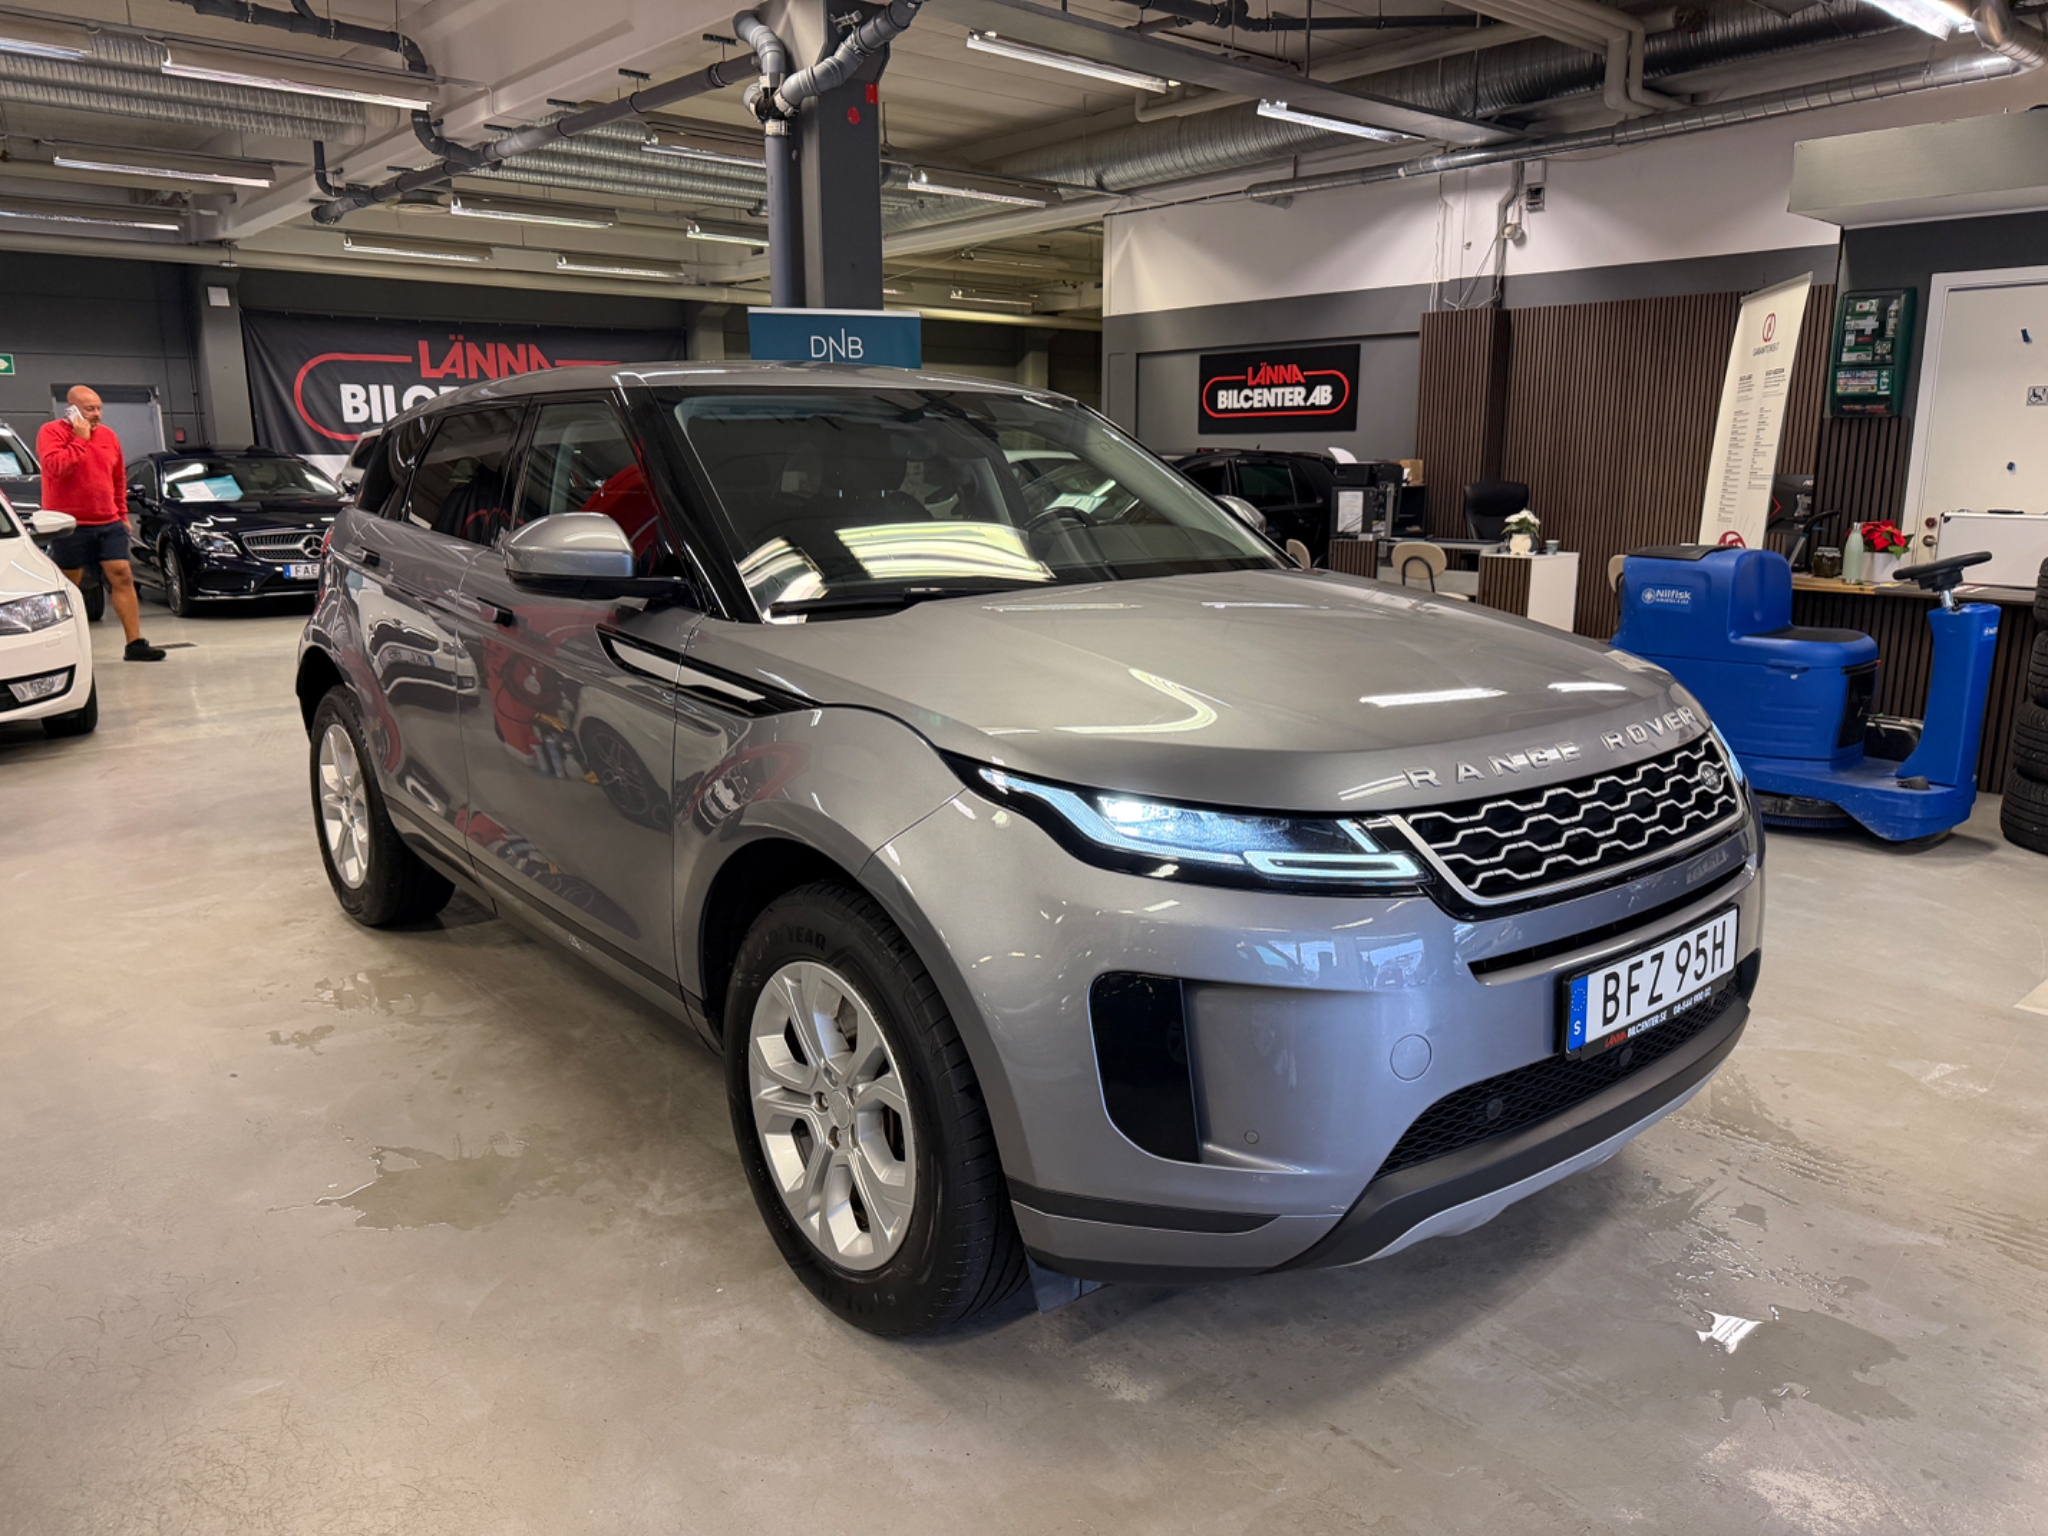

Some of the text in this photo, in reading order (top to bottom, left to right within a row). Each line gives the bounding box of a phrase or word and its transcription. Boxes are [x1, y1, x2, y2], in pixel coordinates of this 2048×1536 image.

[418, 334, 553, 380] LÄNNA
[810, 328, 864, 363] DNB
[1247, 362, 1306, 386] LÄNNA
[1217, 385, 1333, 409] BILCENTER AB
[1655, 588, 1691, 600] Nilfisk
[1403, 705, 1697, 790] RANGE ROVER
[1602, 920, 1726, 1027] BFZ 95H
[1573, 1020, 1581, 1036] S
